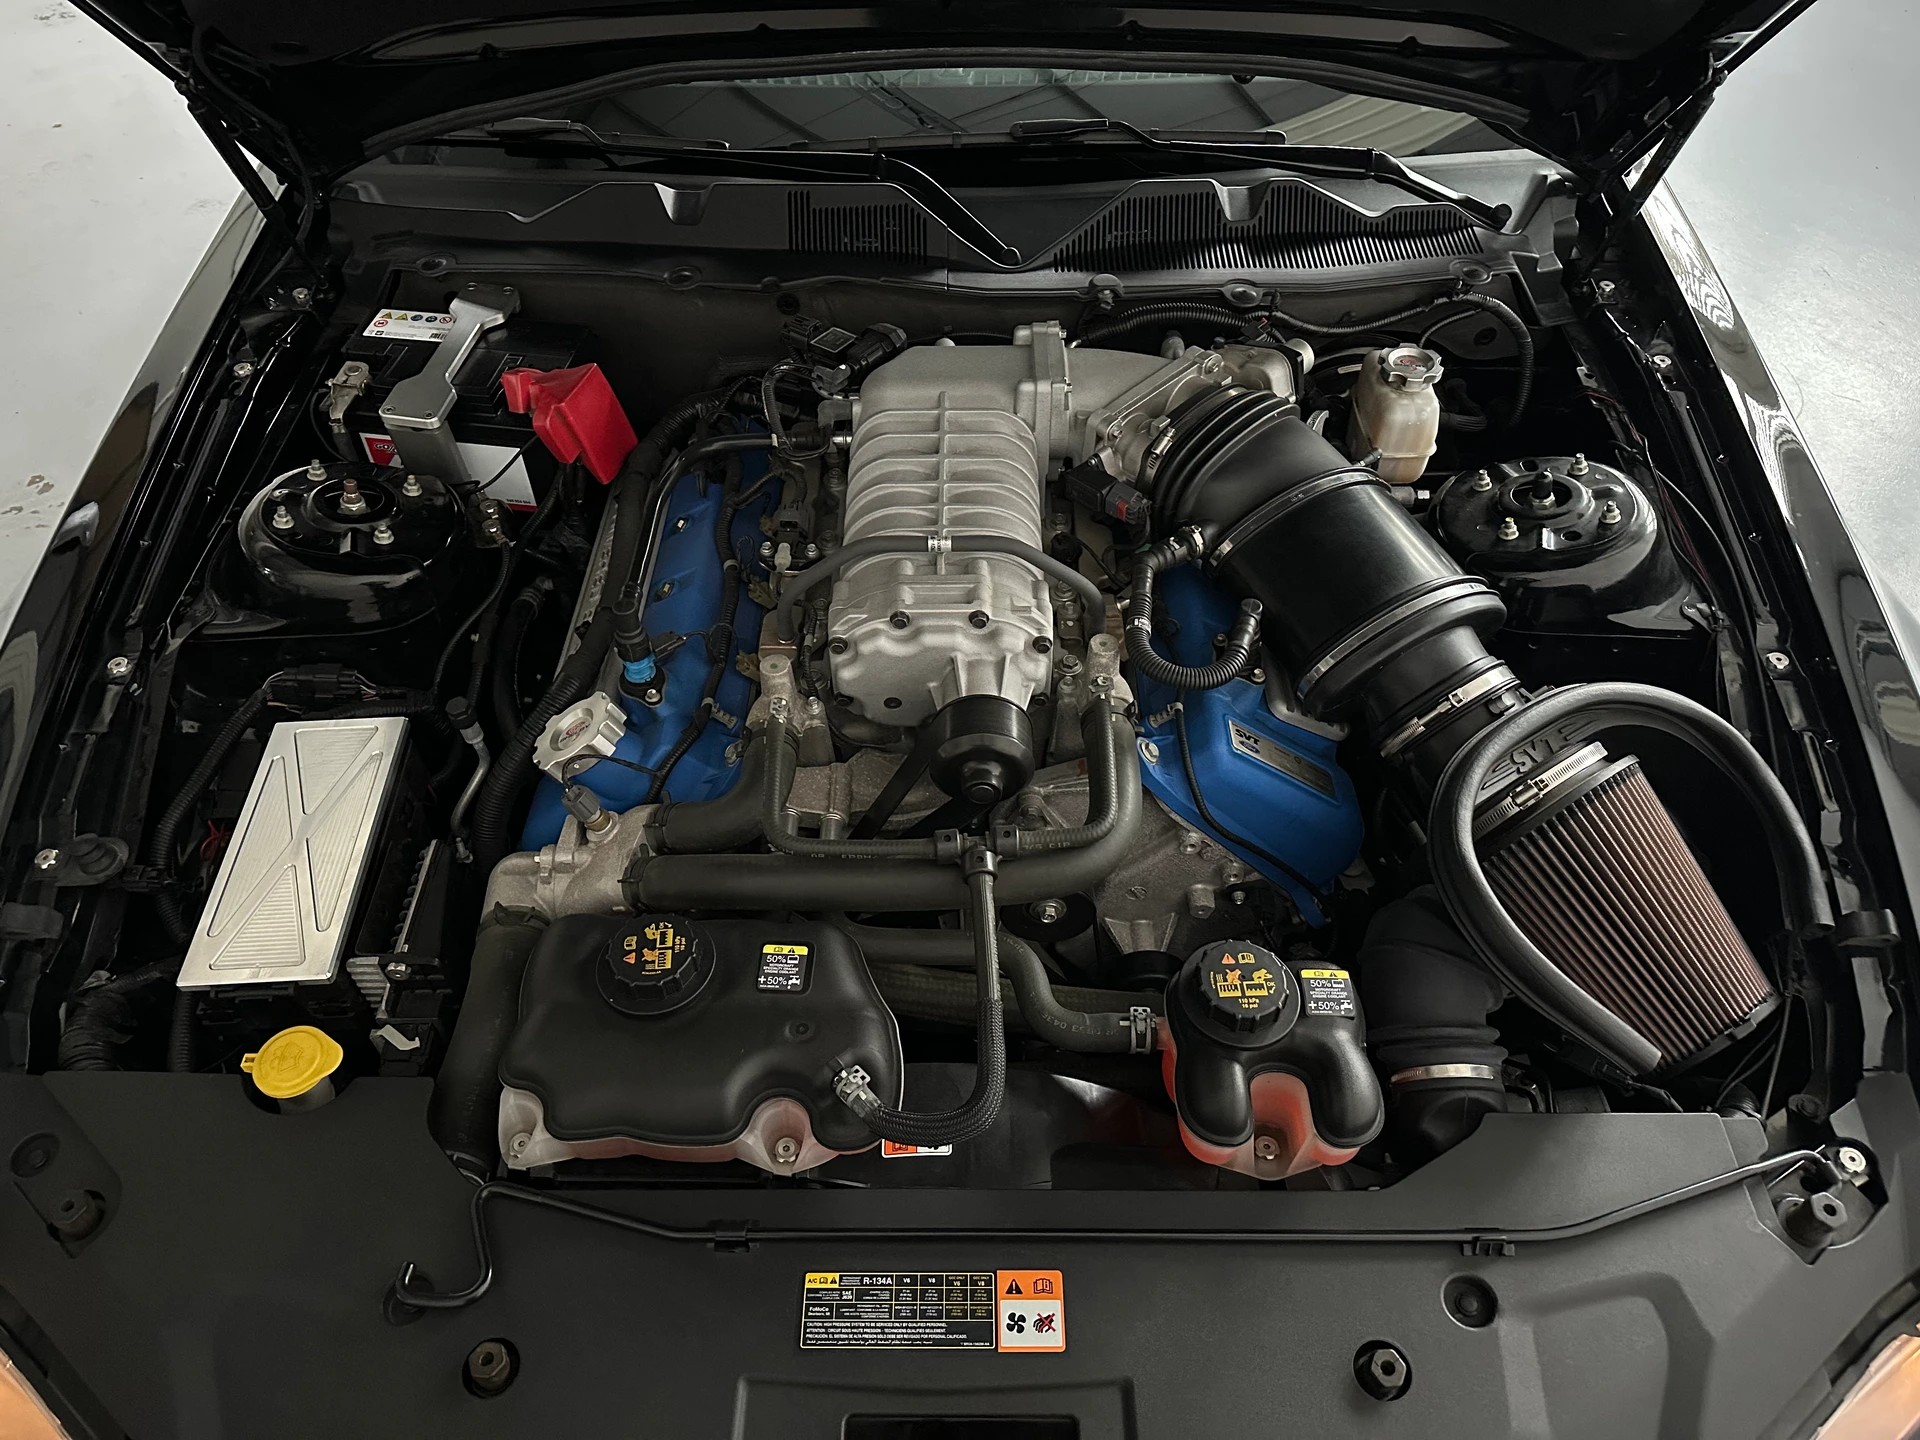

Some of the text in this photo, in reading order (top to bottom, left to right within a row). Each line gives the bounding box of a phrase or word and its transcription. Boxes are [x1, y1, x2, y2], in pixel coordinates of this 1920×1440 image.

[1235, 728, 1260, 746] SVT
[1508, 733, 1566, 776] SVT
[766, 955, 786, 963] 50%
